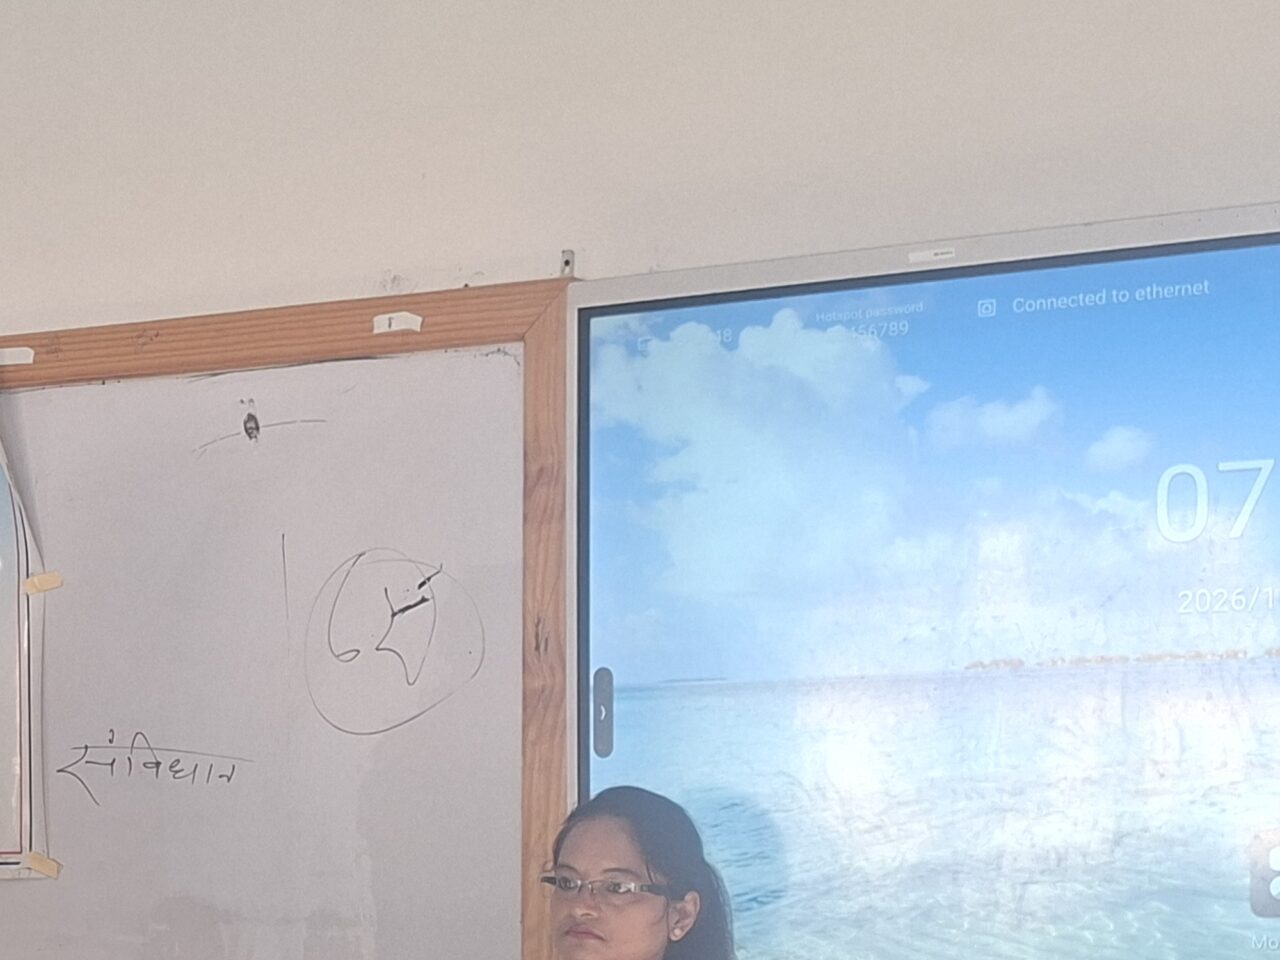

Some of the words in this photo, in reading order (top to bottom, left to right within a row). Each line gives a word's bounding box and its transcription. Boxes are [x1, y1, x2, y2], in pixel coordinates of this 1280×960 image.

[1012, 288, 1106, 313] Connected
[1112, 289, 1130, 304] to
[1135, 280, 1210, 301] ethernet
[815, 308, 863, 323] Hotspot
[866, 301, 924, 319] password
[852, 319, 910, 338] 56789
[1154, 459, 1276, 545] 07
[1177, 586, 1280, 614] 2026/1
